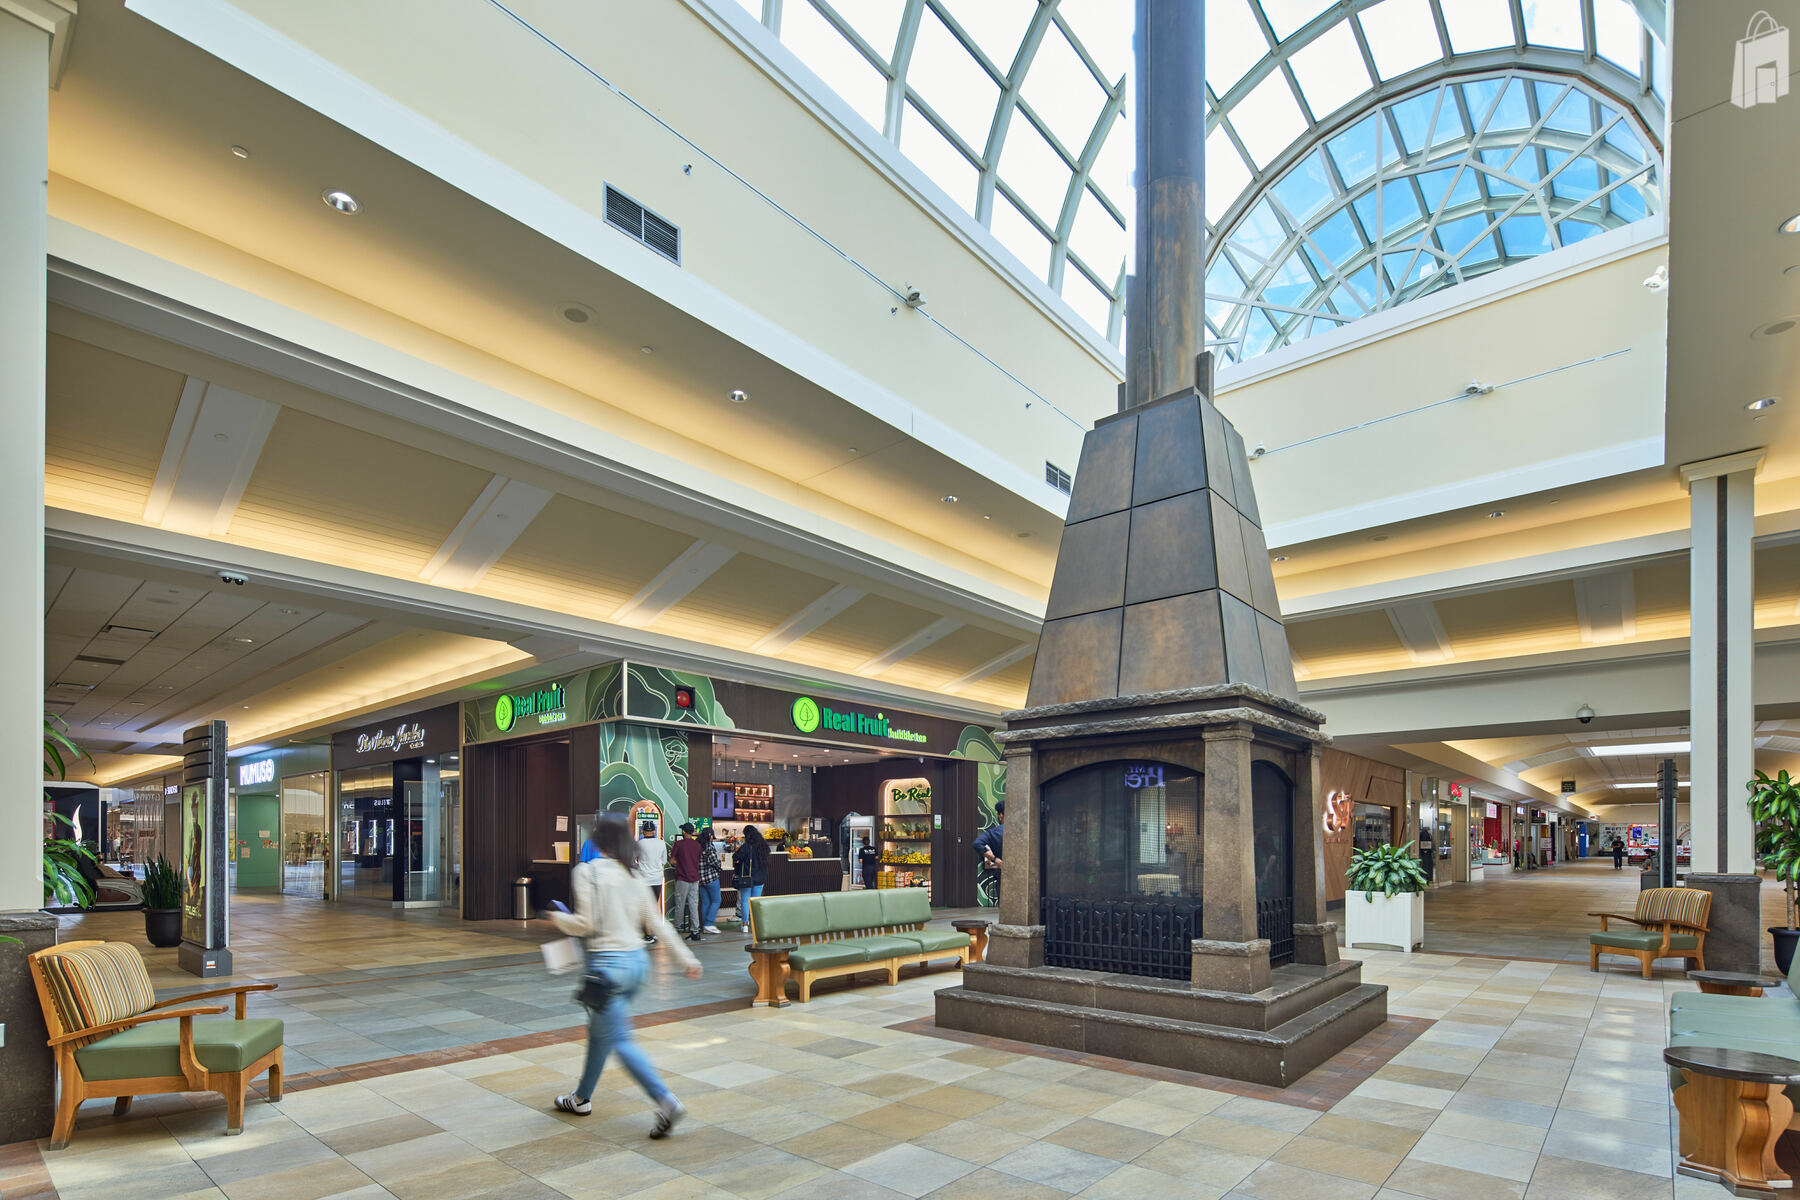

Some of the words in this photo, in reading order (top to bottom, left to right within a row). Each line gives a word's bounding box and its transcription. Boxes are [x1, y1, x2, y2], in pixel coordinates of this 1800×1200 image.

[513, 691, 536, 717] Real
[536, 682, 563, 713] Fruit
[822, 707, 856, 733] Real
[857, 712, 889, 737] Fruit
[888, 727, 914, 742] bubble
[914, 733, 927, 743] tea
[239, 758, 275, 786] MUMUSO
[892, 788, 907, 801] Be
[907, 786, 931, 801] Real
